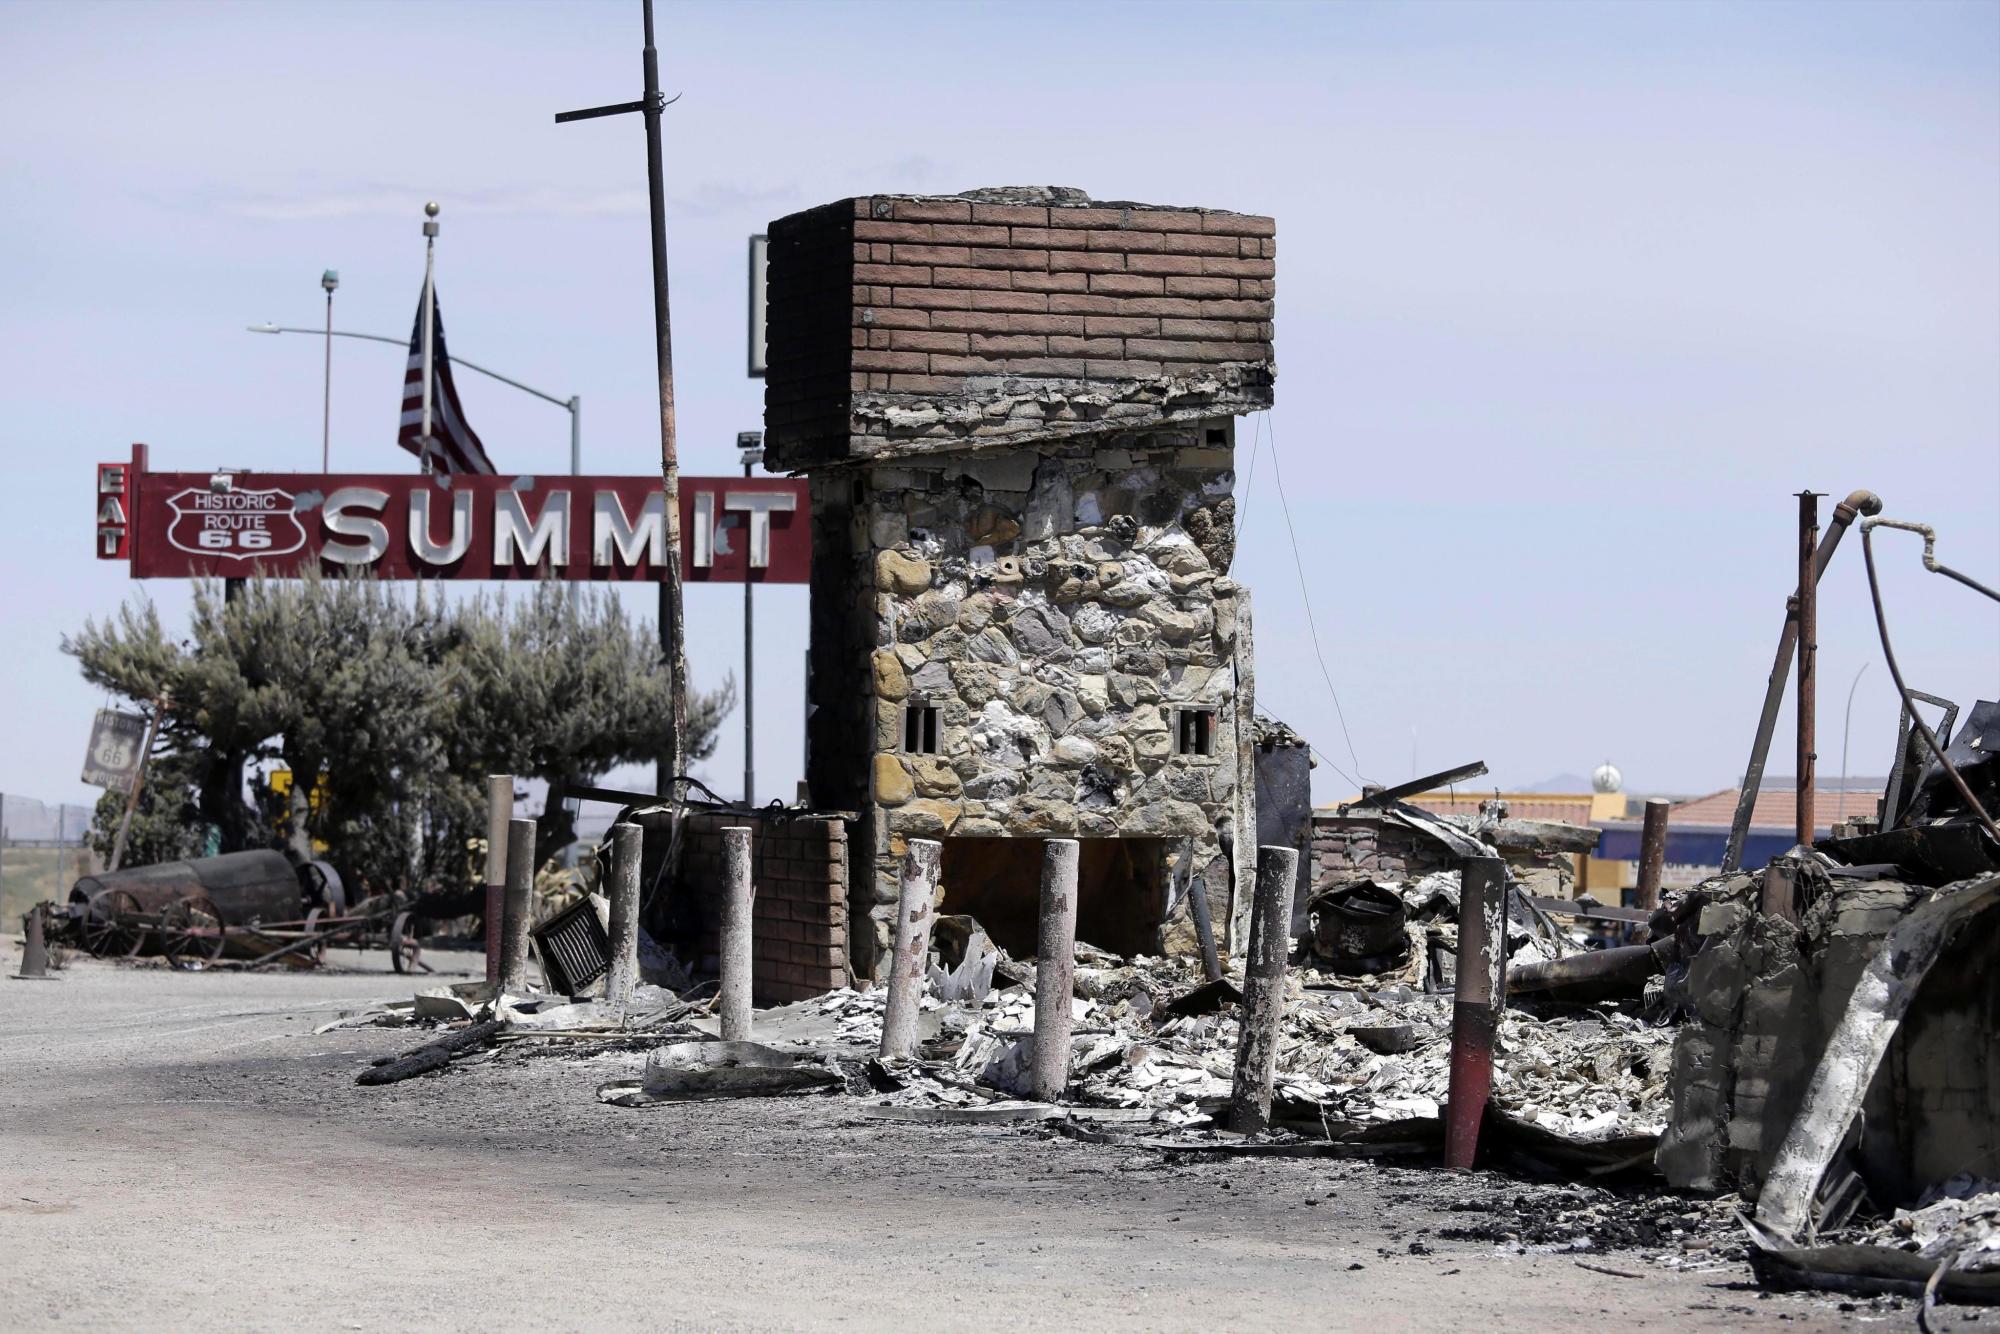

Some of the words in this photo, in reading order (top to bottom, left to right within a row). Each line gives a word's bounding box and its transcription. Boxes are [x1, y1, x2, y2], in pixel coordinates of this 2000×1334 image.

[195, 494, 276, 509] HISTORIC
[99, 467, 126, 554] EAT
[204, 515, 266, 529] ROUTE
[321, 487, 796, 567] SUMMIT
[199, 531, 272, 548] 66
[102, 749, 122, 765] 66
